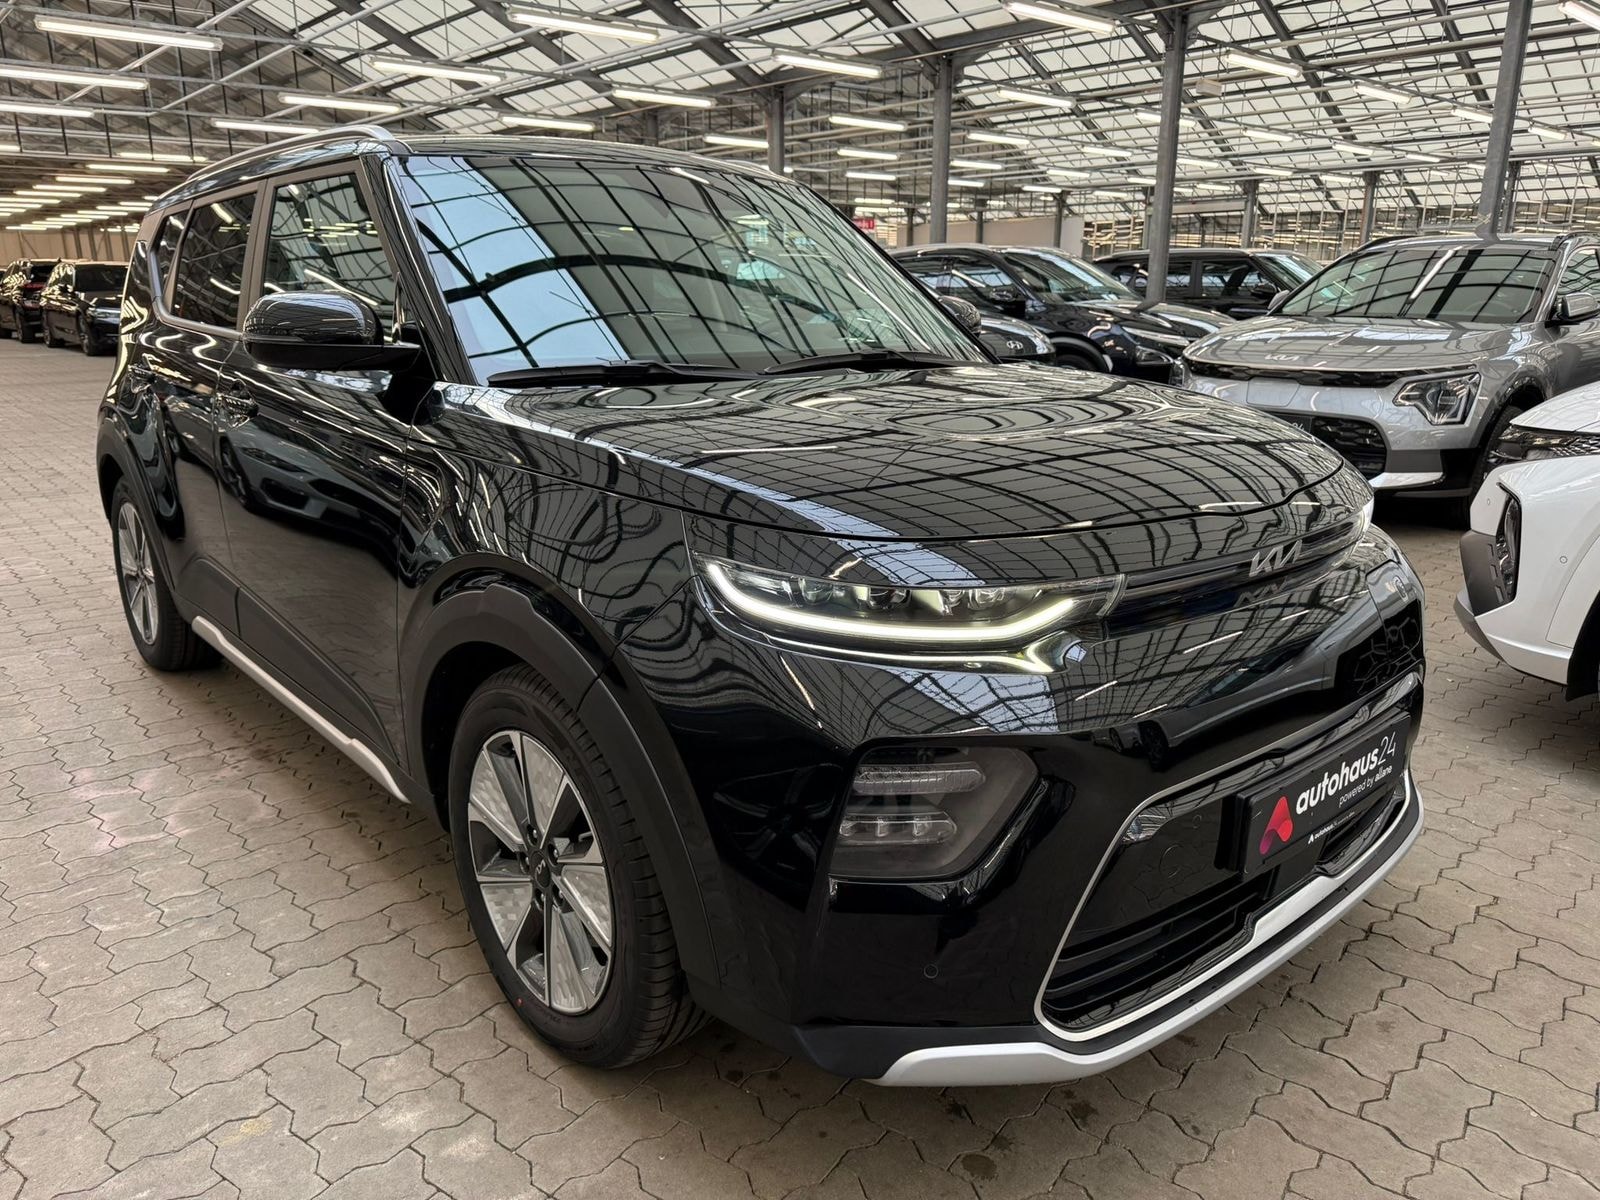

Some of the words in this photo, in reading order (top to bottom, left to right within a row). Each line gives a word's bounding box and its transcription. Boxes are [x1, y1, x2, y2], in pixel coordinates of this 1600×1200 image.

[1249, 538, 1303, 577] KIA
[1296, 731, 1396, 815] autohaus24
[1339, 778, 1367, 809] powered
[1366, 776, 1375, 788] by
